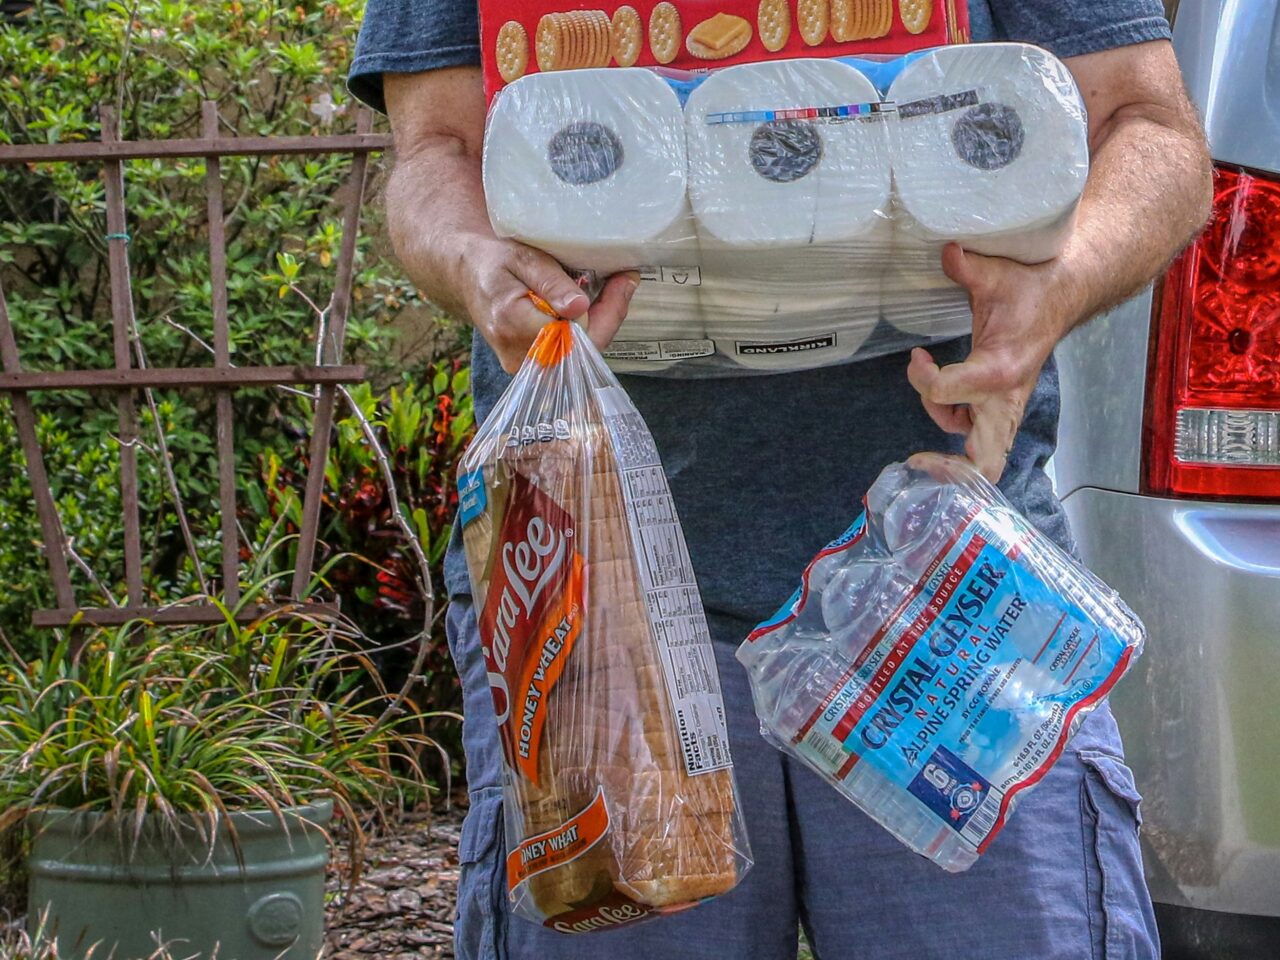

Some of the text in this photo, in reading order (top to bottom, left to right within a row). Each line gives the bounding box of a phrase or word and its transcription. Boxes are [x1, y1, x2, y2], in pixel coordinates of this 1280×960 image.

[743, 340, 826, 353] KIRKLAND
[503, 517, 565, 620] Lee
[927, 560, 953, 591] GEYSER
[855, 648, 944, 756] CRYSTAL
[922, 556, 1008, 663] GEYSER
[856, 658, 897, 710] BOTTLED
[894, 640, 910, 658] AT
[908, 613, 929, 638] THE
[927, 566, 964, 612] SOURCE
[1047, 649, 1066, 672] CRYSTAL
[1061, 625, 1081, 651] GEYSER
[518, 616, 572, 758] HONEY WHEAT
[895, 594, 1028, 768] ALPINE SPRING WATER
[912, 619, 992, 722] NATURAL
[960, 665, 1003, 720] BY CG ROXANE
[676, 709, 695, 771] Nutrition
[689, 731, 702, 769] Facts
[1020, 753, 1038, 773] 101.5
[1033, 746, 1045, 758] FL
[1039, 737, 1052, 750] OZ
[1026, 739, 1037, 750] FL
[1031, 728, 1044, 741] OZ
[918, 759, 953, 791] 6
